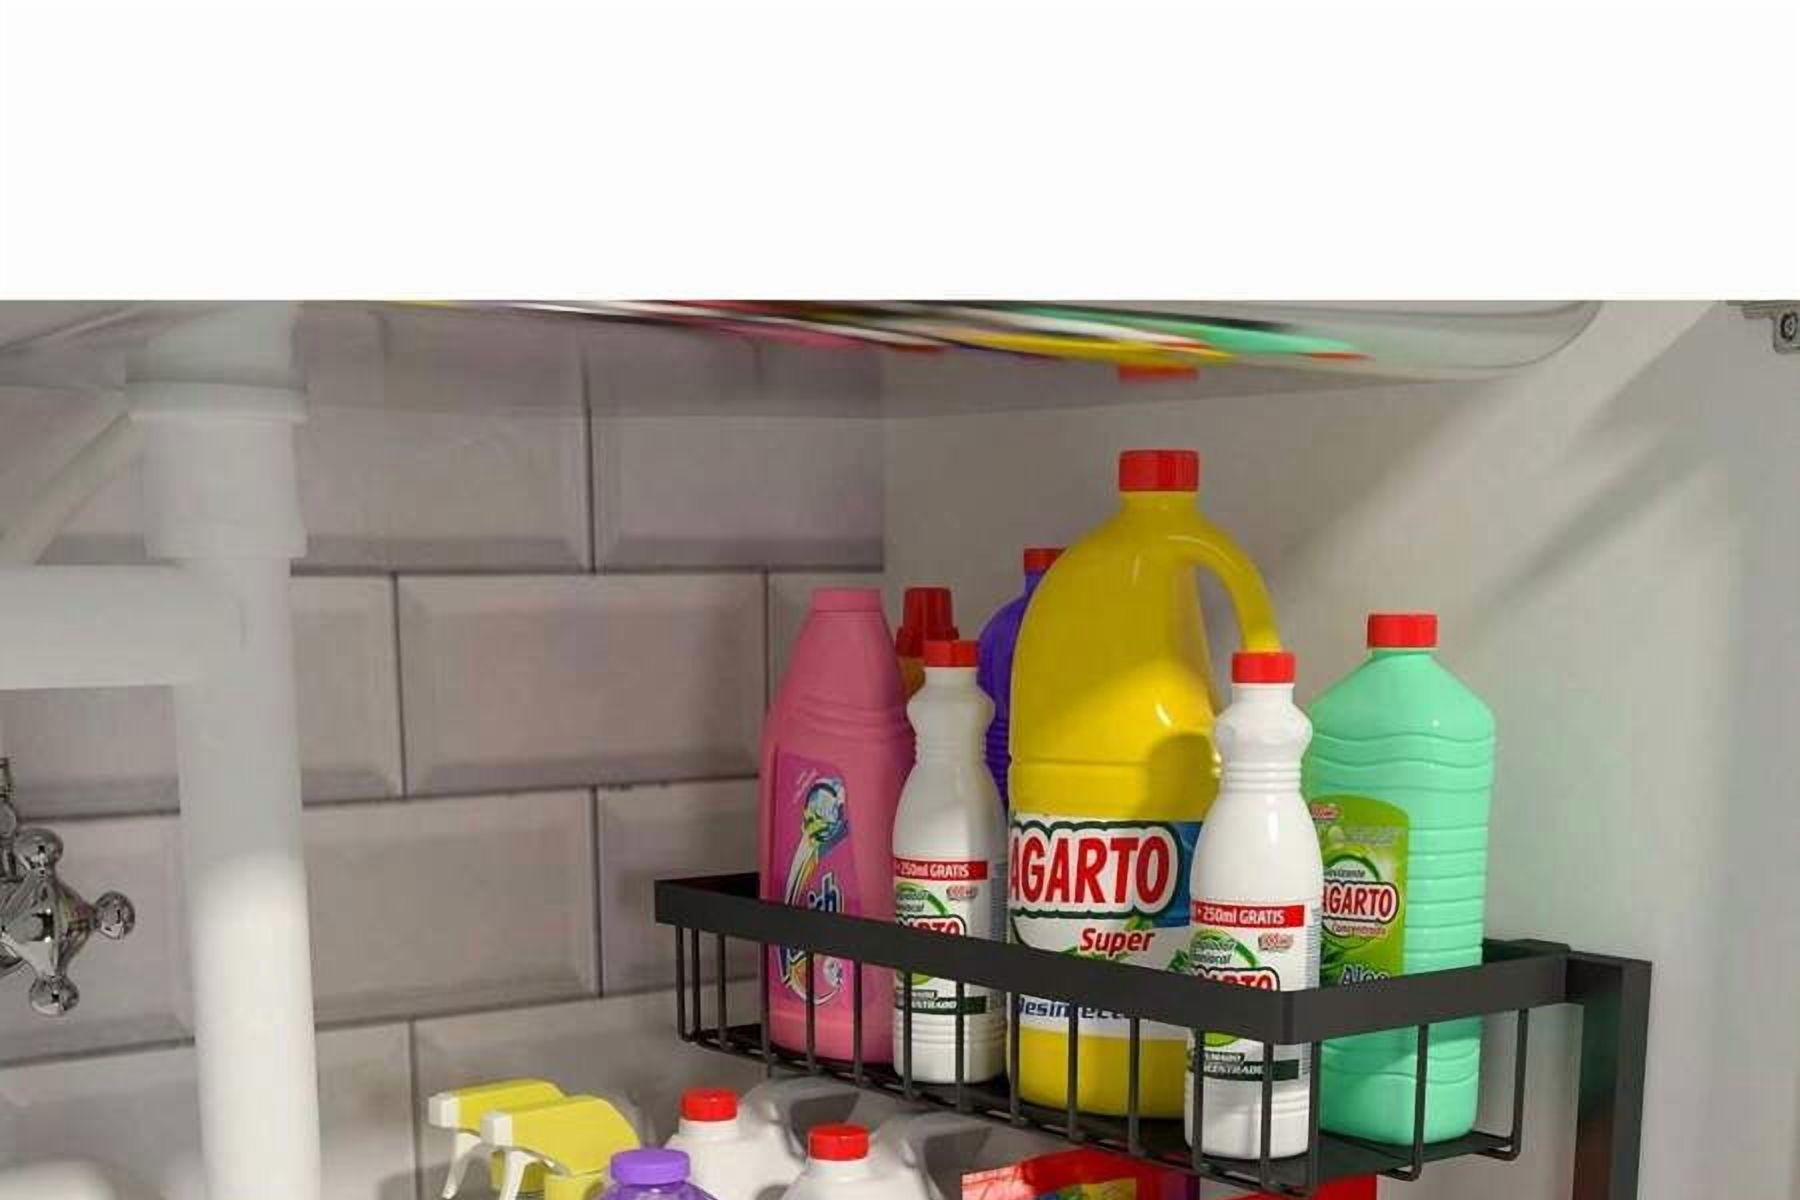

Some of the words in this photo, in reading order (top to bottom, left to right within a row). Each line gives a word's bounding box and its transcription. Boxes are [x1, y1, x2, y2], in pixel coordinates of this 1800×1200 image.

[930, 863, 970, 879] GRATIS
[1202, 905, 1238, 923] 250ml
[1239, 909, 1286, 926] GRATIS
[1079, 928, 1156, 958] Super
